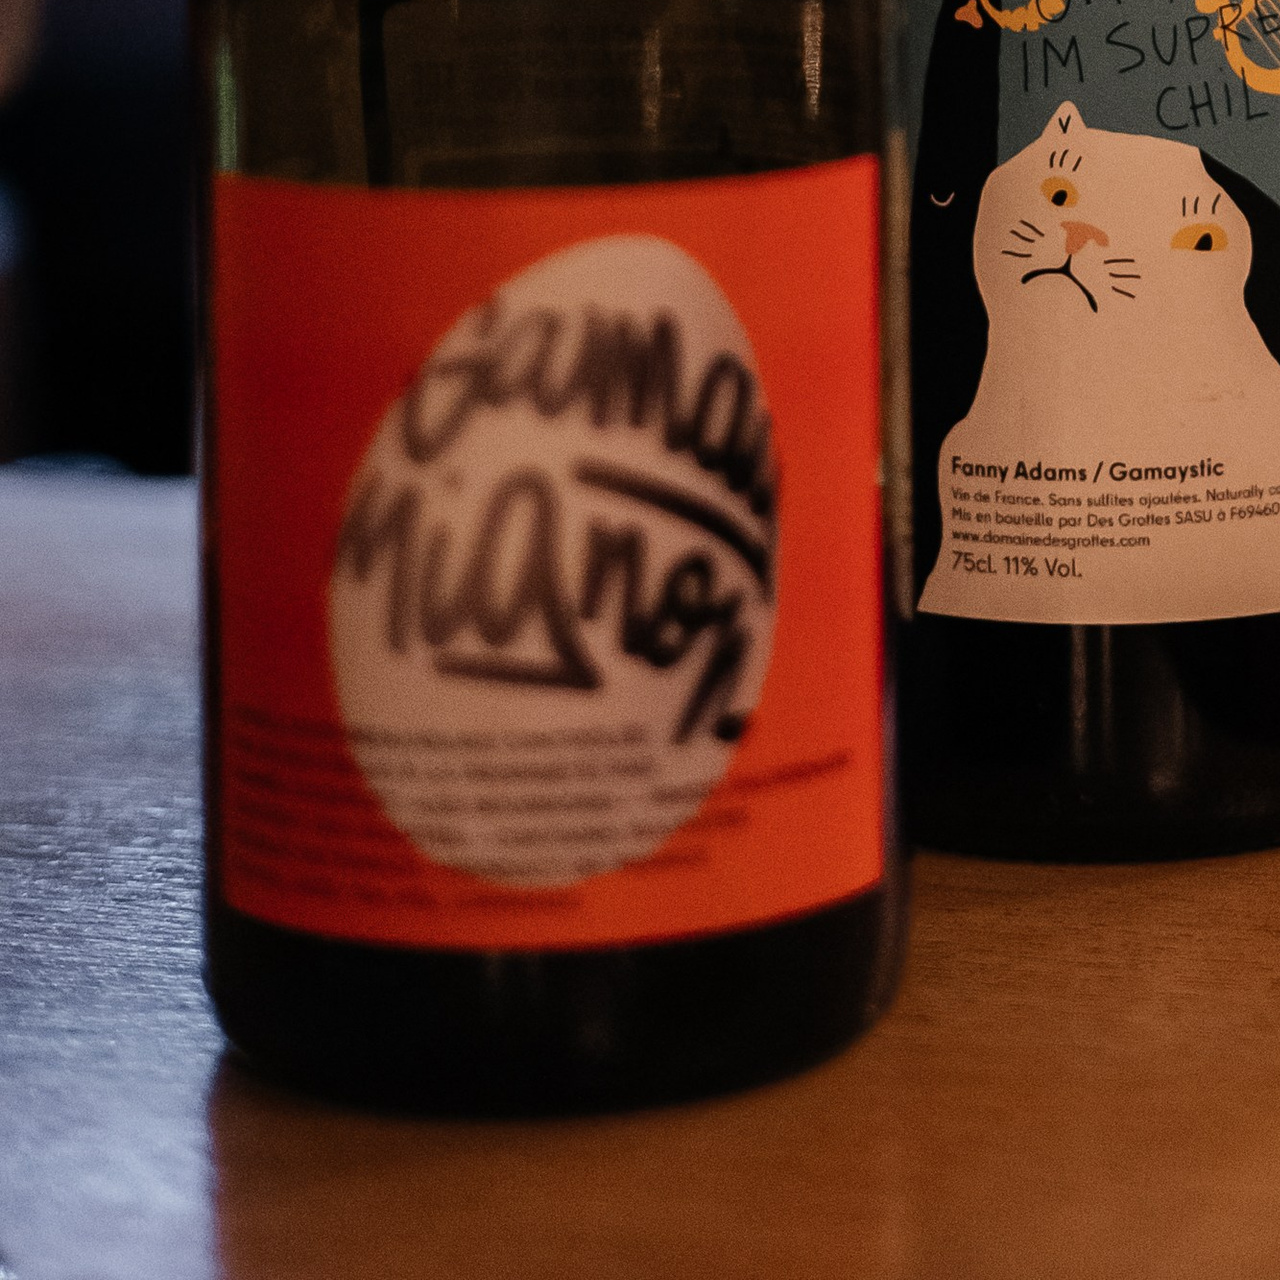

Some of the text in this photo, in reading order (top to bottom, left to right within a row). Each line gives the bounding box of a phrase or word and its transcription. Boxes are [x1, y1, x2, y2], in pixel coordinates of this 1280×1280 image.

[1023, 35, 1085, 92] IM
[951, 456, 1225, 483] Fanny Adams / Gamaystic
[973, 489, 990, 503] de
[995, 490, 1043, 506] France.
[1048, 493, 1082, 507] Sans
[1086, 492, 1134, 507] sulfites
[1139, 491, 1201, 509] ajoutées.
[1205, 486, 1265, 503] Naturally
[951, 507, 974, 522] Mis
[976, 512, 991, 523] en
[995, 509, 1053, 526] bouteille
[1058, 515, 1082, 530] par
[1087, 513, 1114, 527] Des
[1118, 511, 1171, 527] Grottes
[1175, 509, 1212, 525] SASU
[1230, 502, 1280, 520] F69460
[951, 529, 1150, 550] www.domainedesgrottes.com
[1003, 555, 1038, 576] 11%
[1045, 557, 1082, 578] Vol.
